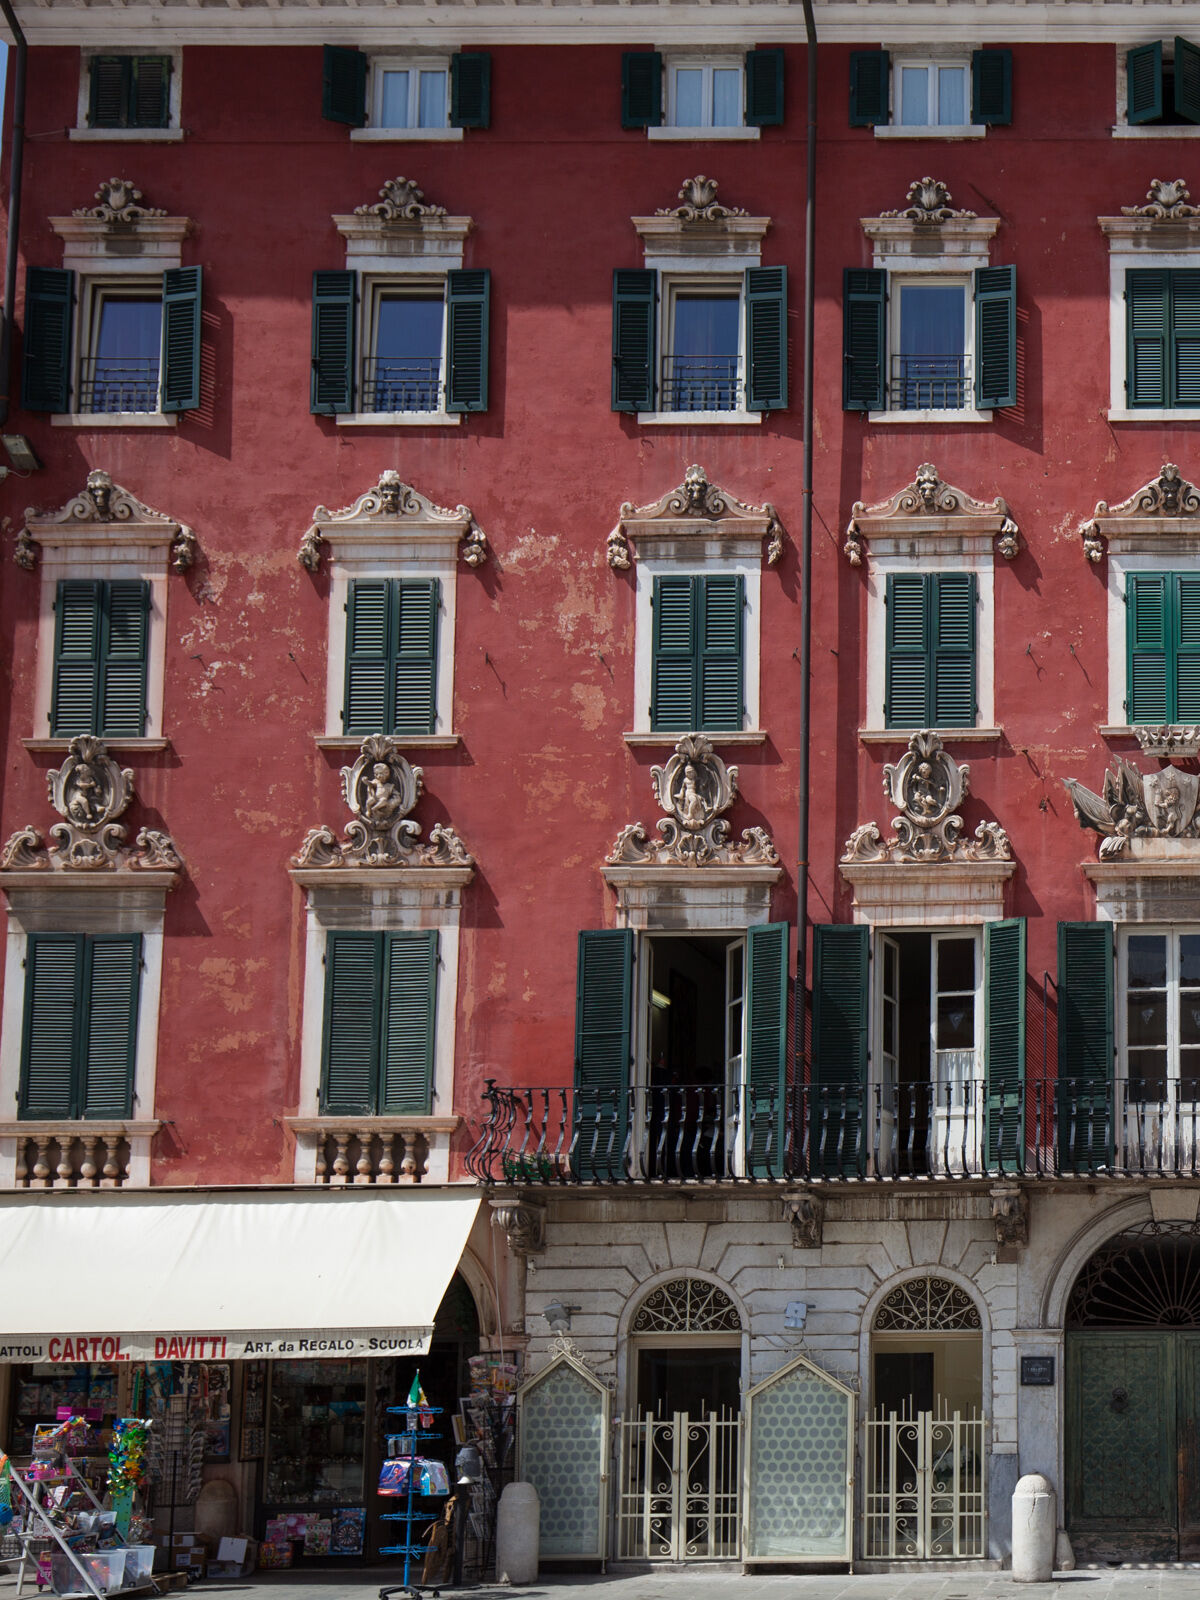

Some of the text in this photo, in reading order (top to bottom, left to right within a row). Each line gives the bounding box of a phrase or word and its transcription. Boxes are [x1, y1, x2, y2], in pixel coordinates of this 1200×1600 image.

[49, 1337, 130, 1361] CARTOL.
[155, 1336, 227, 1359] DAVITTI
[243, 1341, 273, 1353] ART.
[278, 1342, 294, 1352] da
[299, 1339, 354, 1350] REGALO
[368, 1338, 423, 1350] SCUOLA
